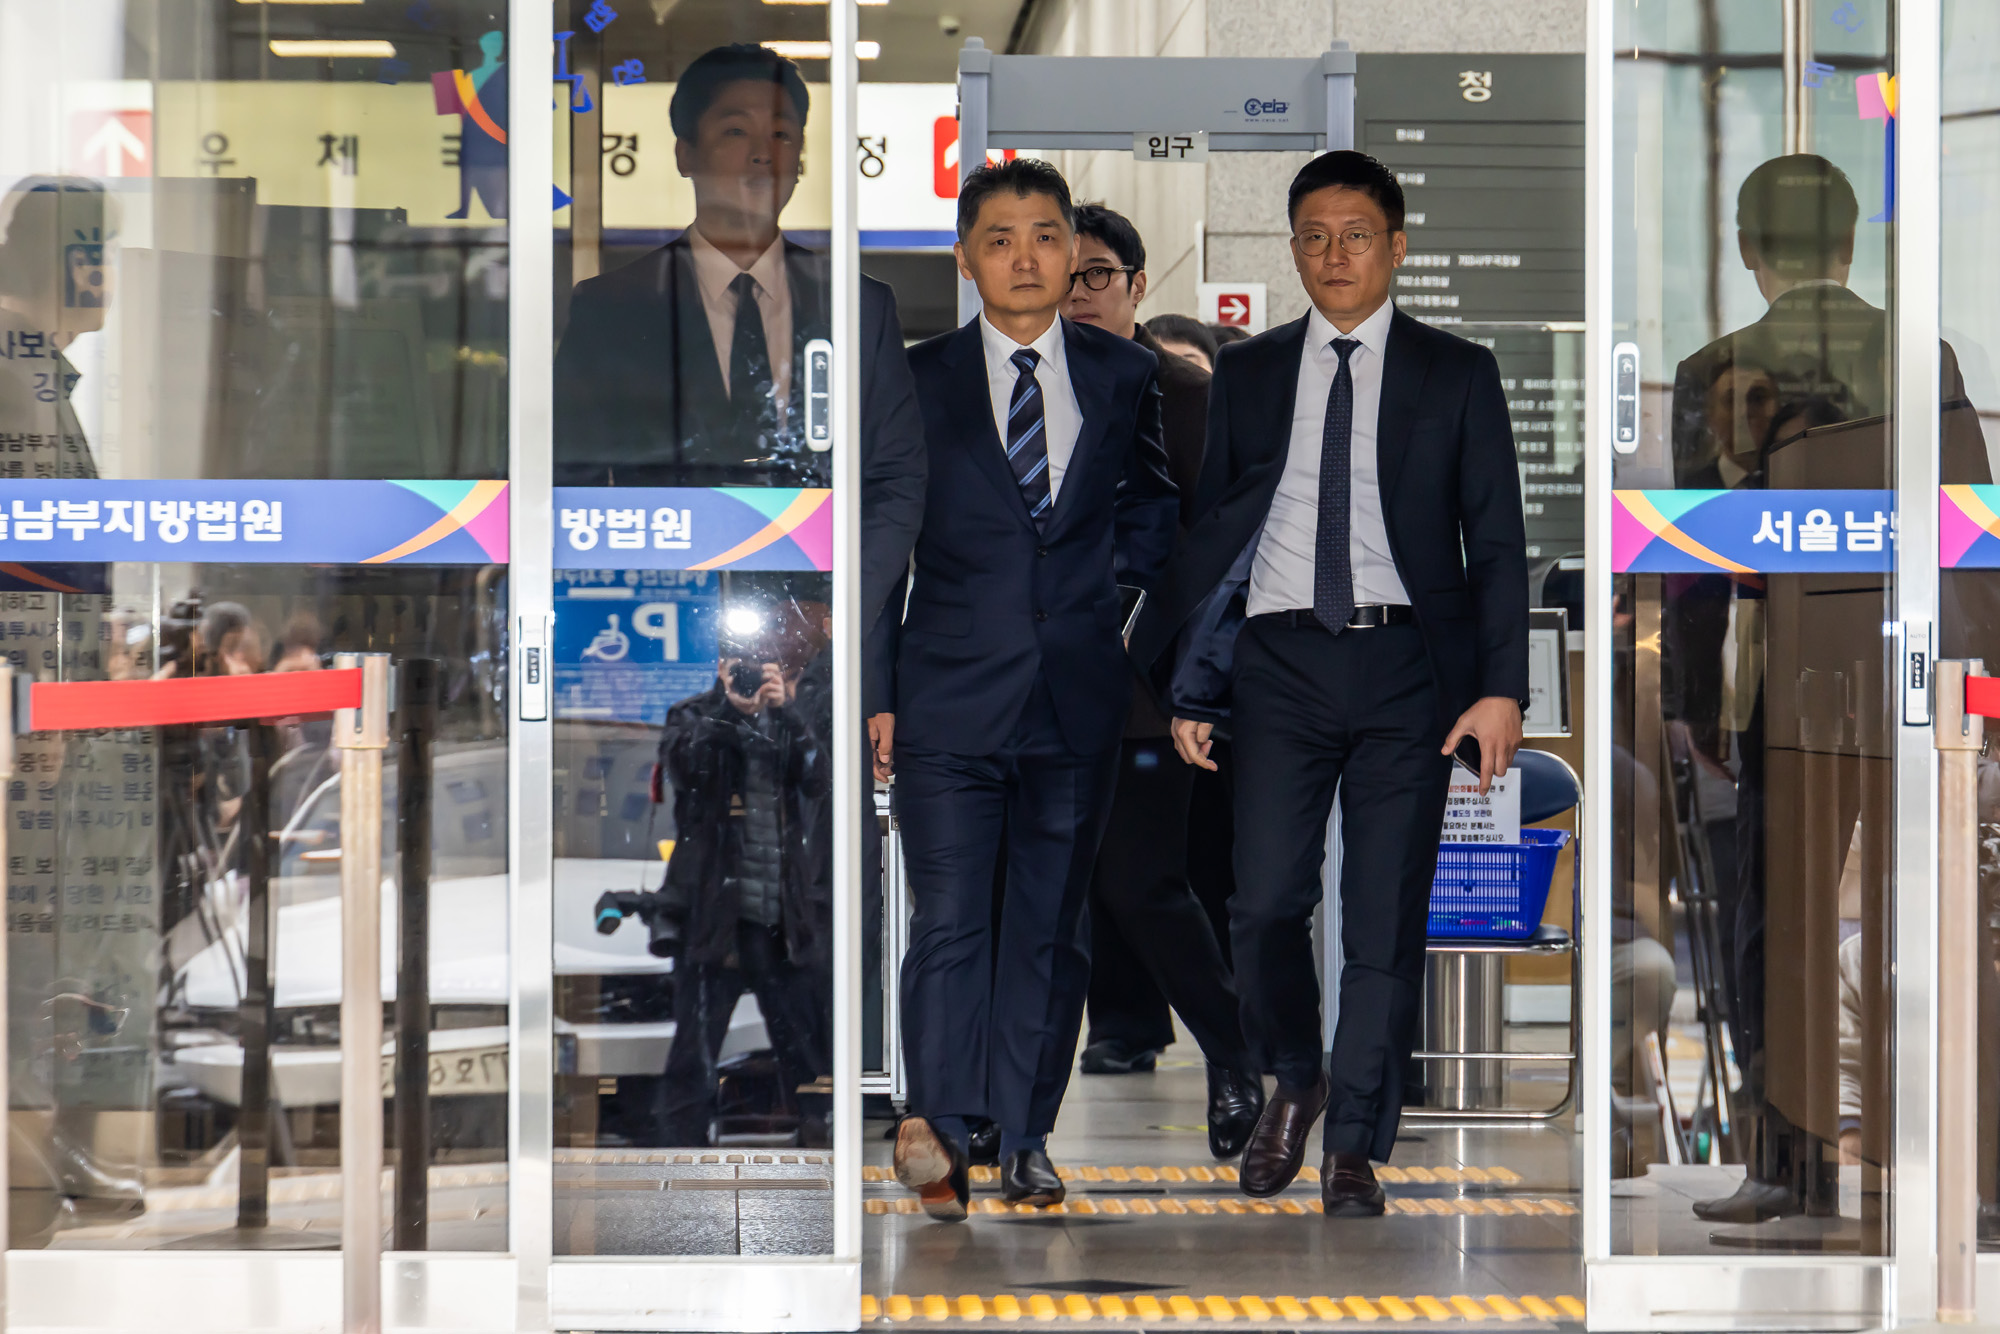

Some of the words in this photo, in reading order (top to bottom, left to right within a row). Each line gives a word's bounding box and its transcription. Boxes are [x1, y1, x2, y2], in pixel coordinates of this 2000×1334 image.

[1458, 70, 1493, 103] 청
[1148, 136, 1194, 158] 입구
[0, 499, 282, 543] 남부지방법원
[552, 507, 692, 551] 방법원
[1752, 508, 1899, 552] 서울남
